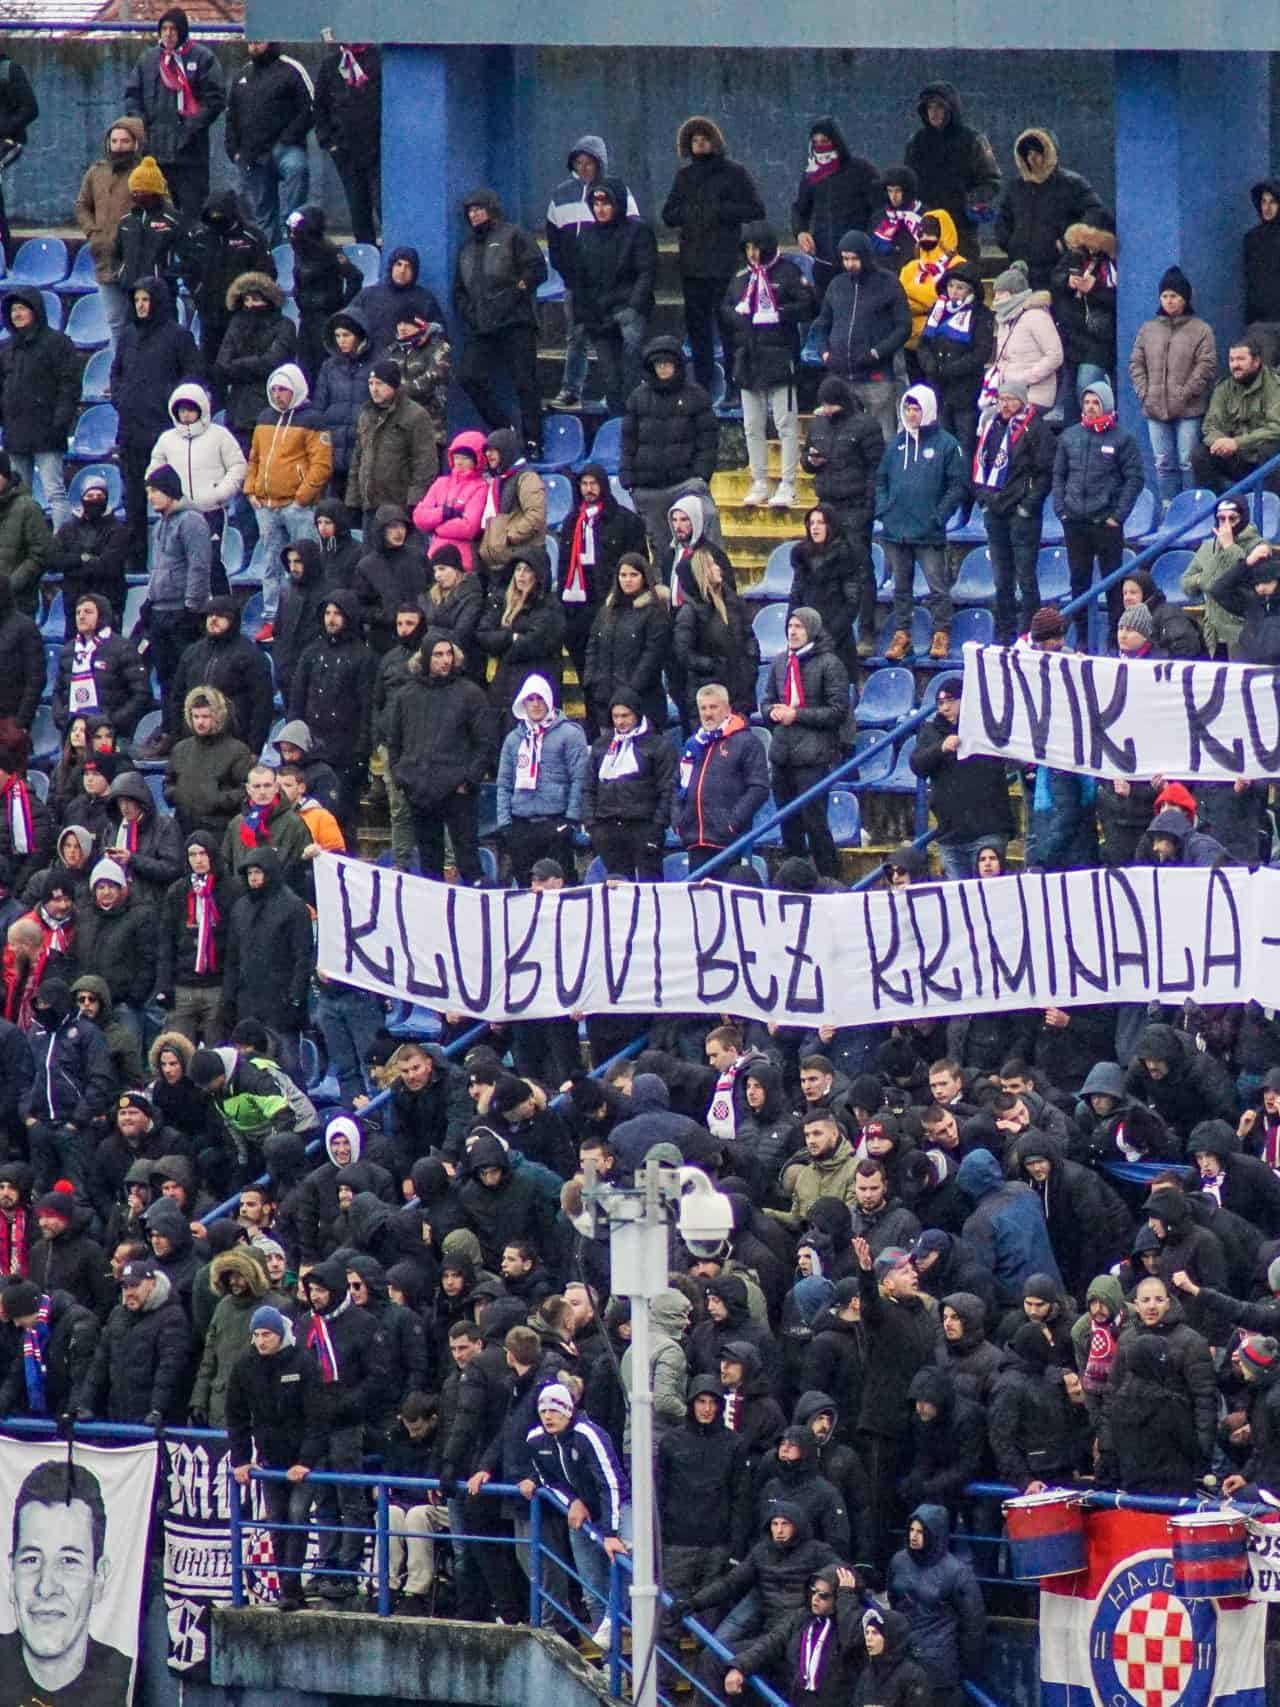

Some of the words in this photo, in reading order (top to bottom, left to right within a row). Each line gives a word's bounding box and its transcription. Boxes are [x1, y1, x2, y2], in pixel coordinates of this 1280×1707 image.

[975, 647, 1138, 774] UVIK
[337, 862, 662, 1013] KLUBOVI
[688, 881, 825, 1013] BEZ
[864, 867, 1243, 1010] KRIMINALA
